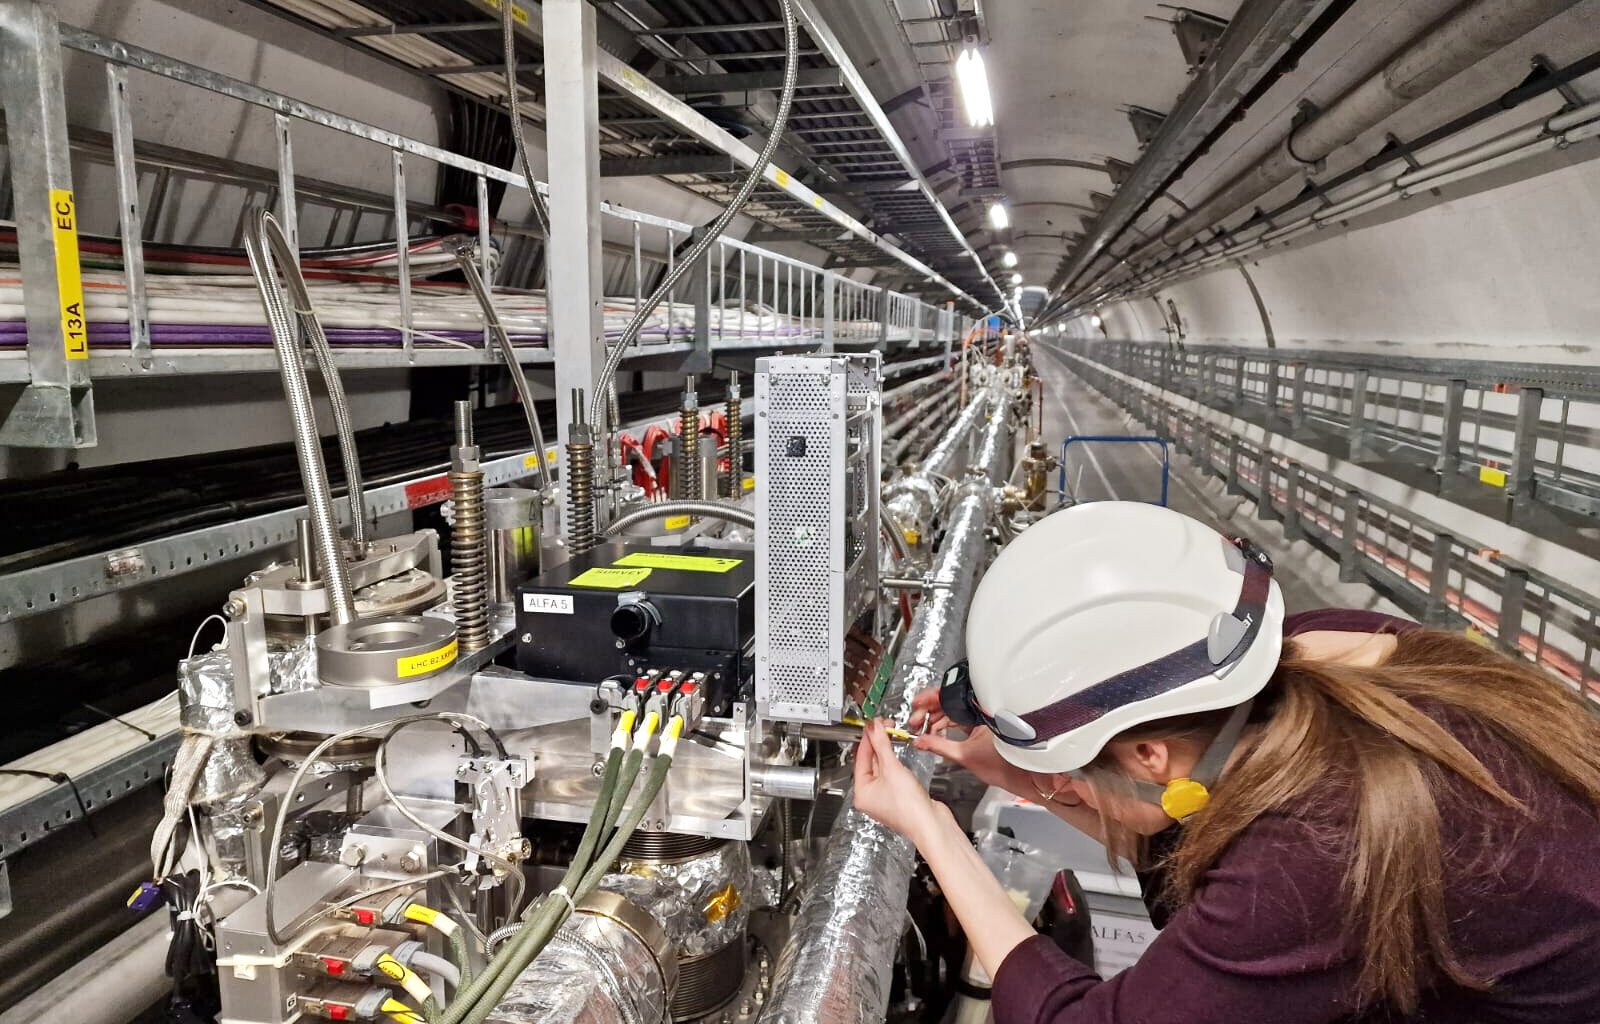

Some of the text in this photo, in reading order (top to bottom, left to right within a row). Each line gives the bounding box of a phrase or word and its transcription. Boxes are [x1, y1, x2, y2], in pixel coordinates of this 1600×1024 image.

[66, 302, 84, 353] L13A
[529, 597, 568, 609] ALFA 5
